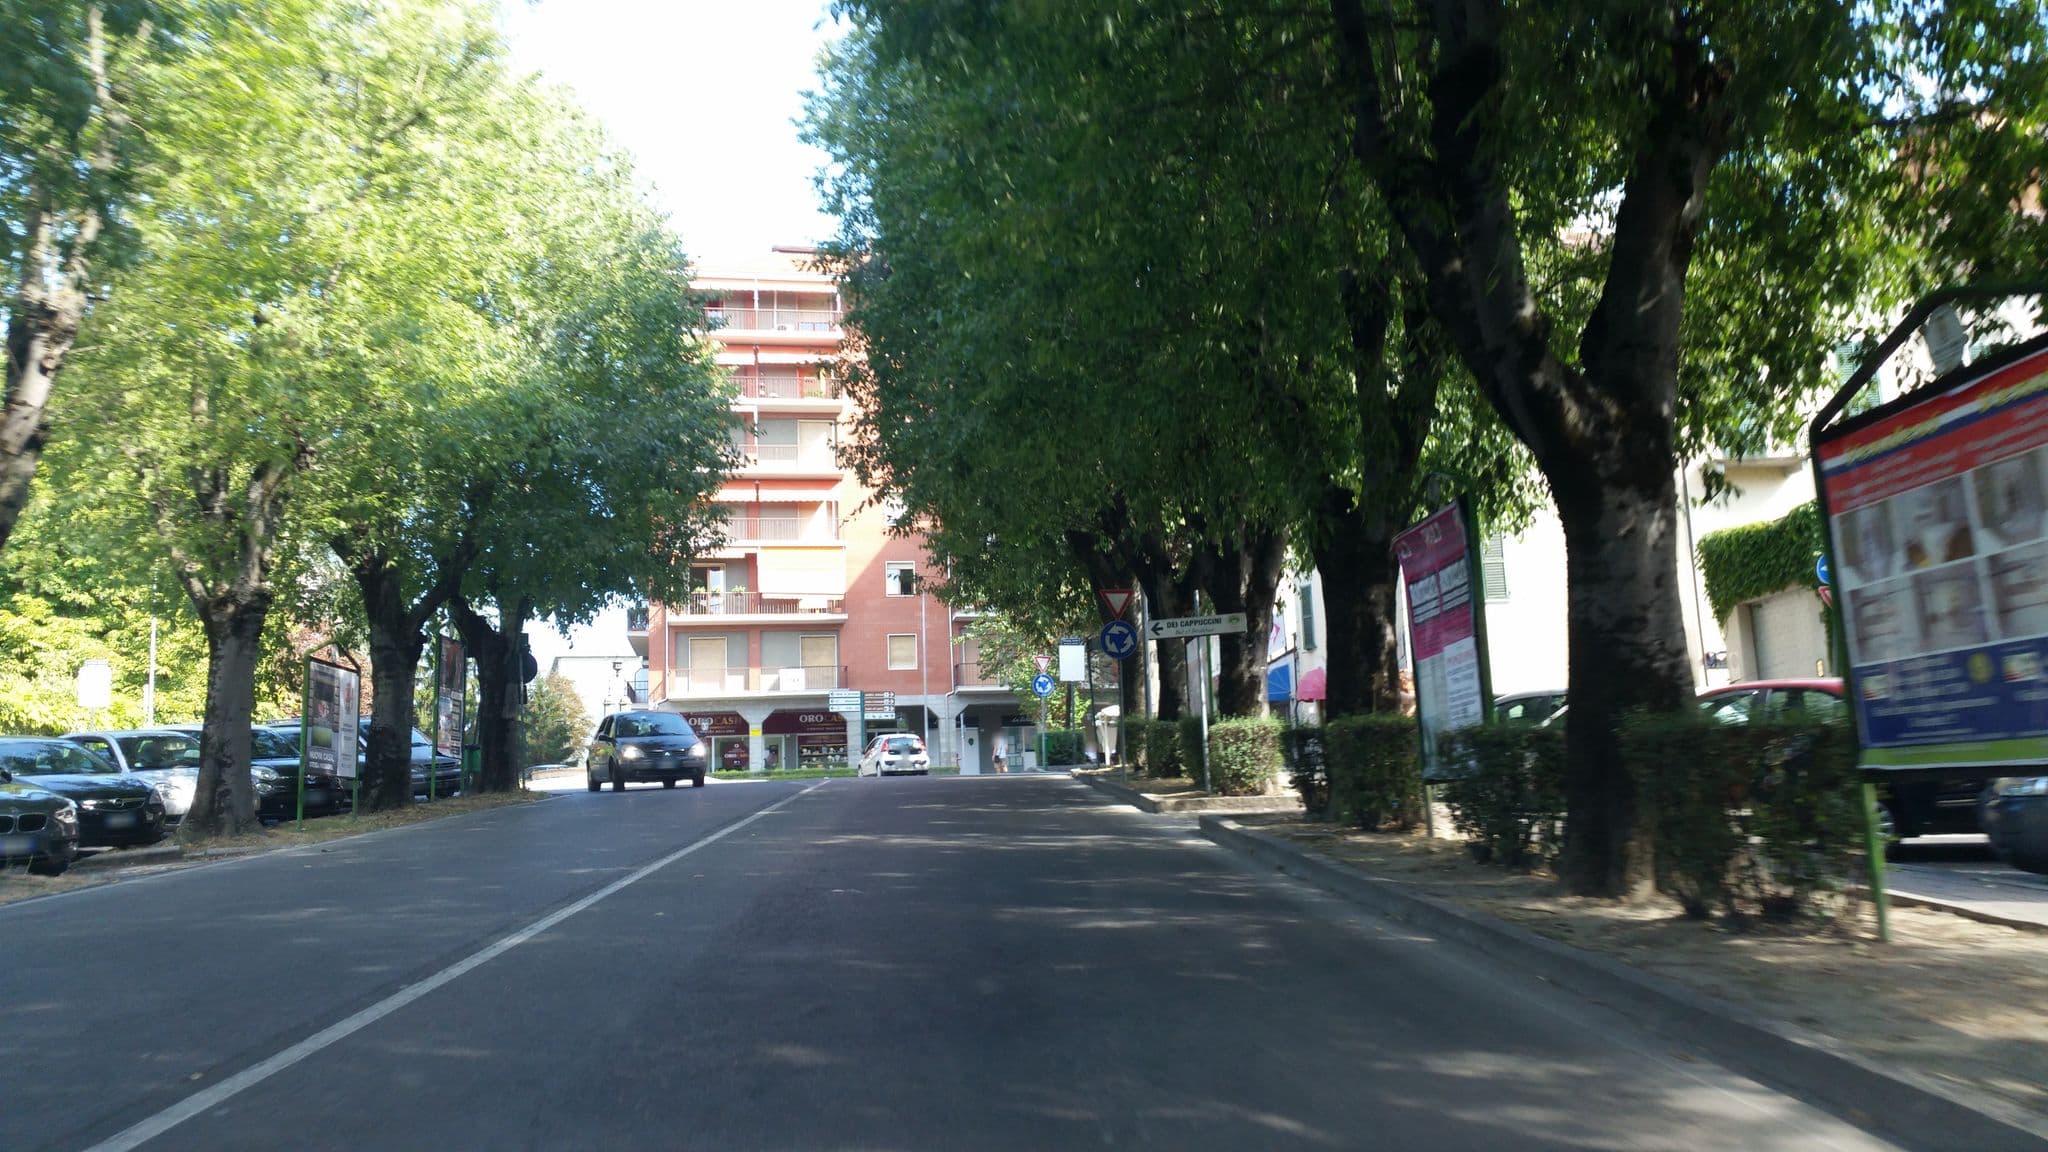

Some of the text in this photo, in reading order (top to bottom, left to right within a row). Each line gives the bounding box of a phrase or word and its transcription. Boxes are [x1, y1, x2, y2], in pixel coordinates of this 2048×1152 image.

[1166, 617, 1222, 629] DEI CAPPUCCINI
[799, 714, 824, 723] ORO
